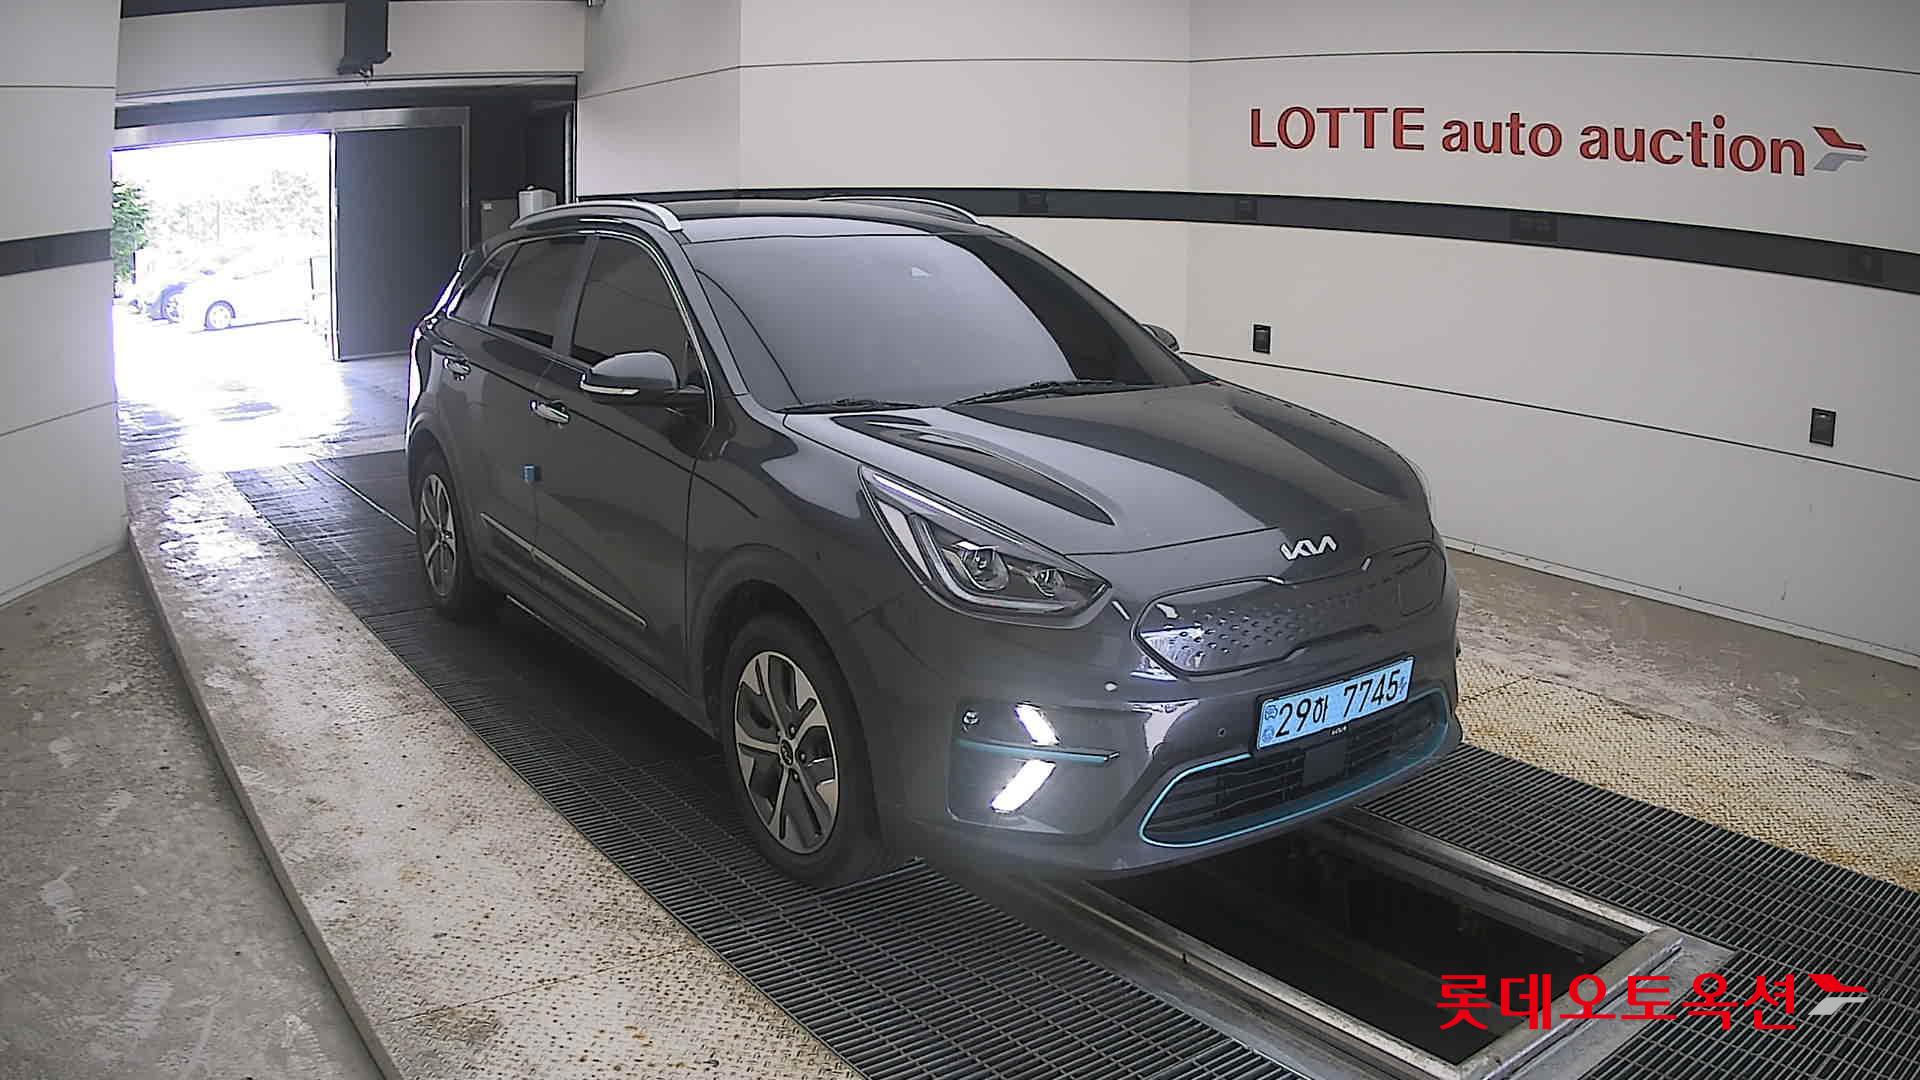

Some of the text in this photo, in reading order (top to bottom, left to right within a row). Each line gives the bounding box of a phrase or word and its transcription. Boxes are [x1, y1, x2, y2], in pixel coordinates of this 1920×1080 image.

[1250, 106, 1806, 177] LOTTE auto auction
[1275, 668, 1400, 738] 29하 7745
